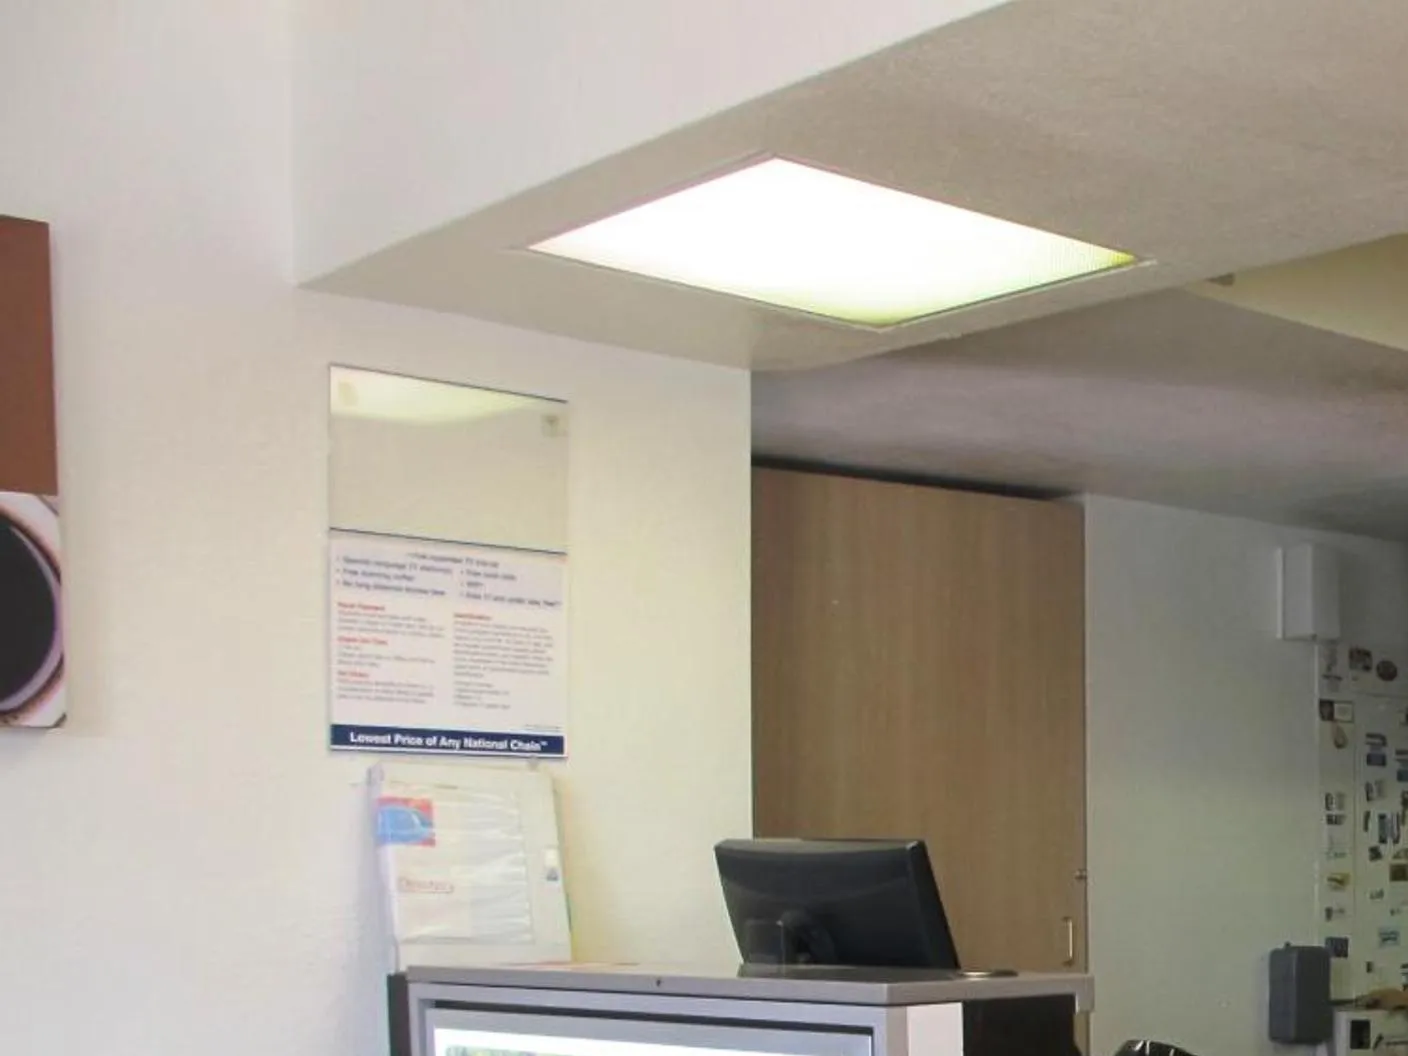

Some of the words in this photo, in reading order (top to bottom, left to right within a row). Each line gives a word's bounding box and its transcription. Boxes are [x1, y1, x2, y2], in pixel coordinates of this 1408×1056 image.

[350, 731, 392, 744] Lowest
[393, 733, 424, 746] Price
[425, 735, 438, 746] of
[439, 736, 460, 751] Any
[463, 736, 508, 750] National
